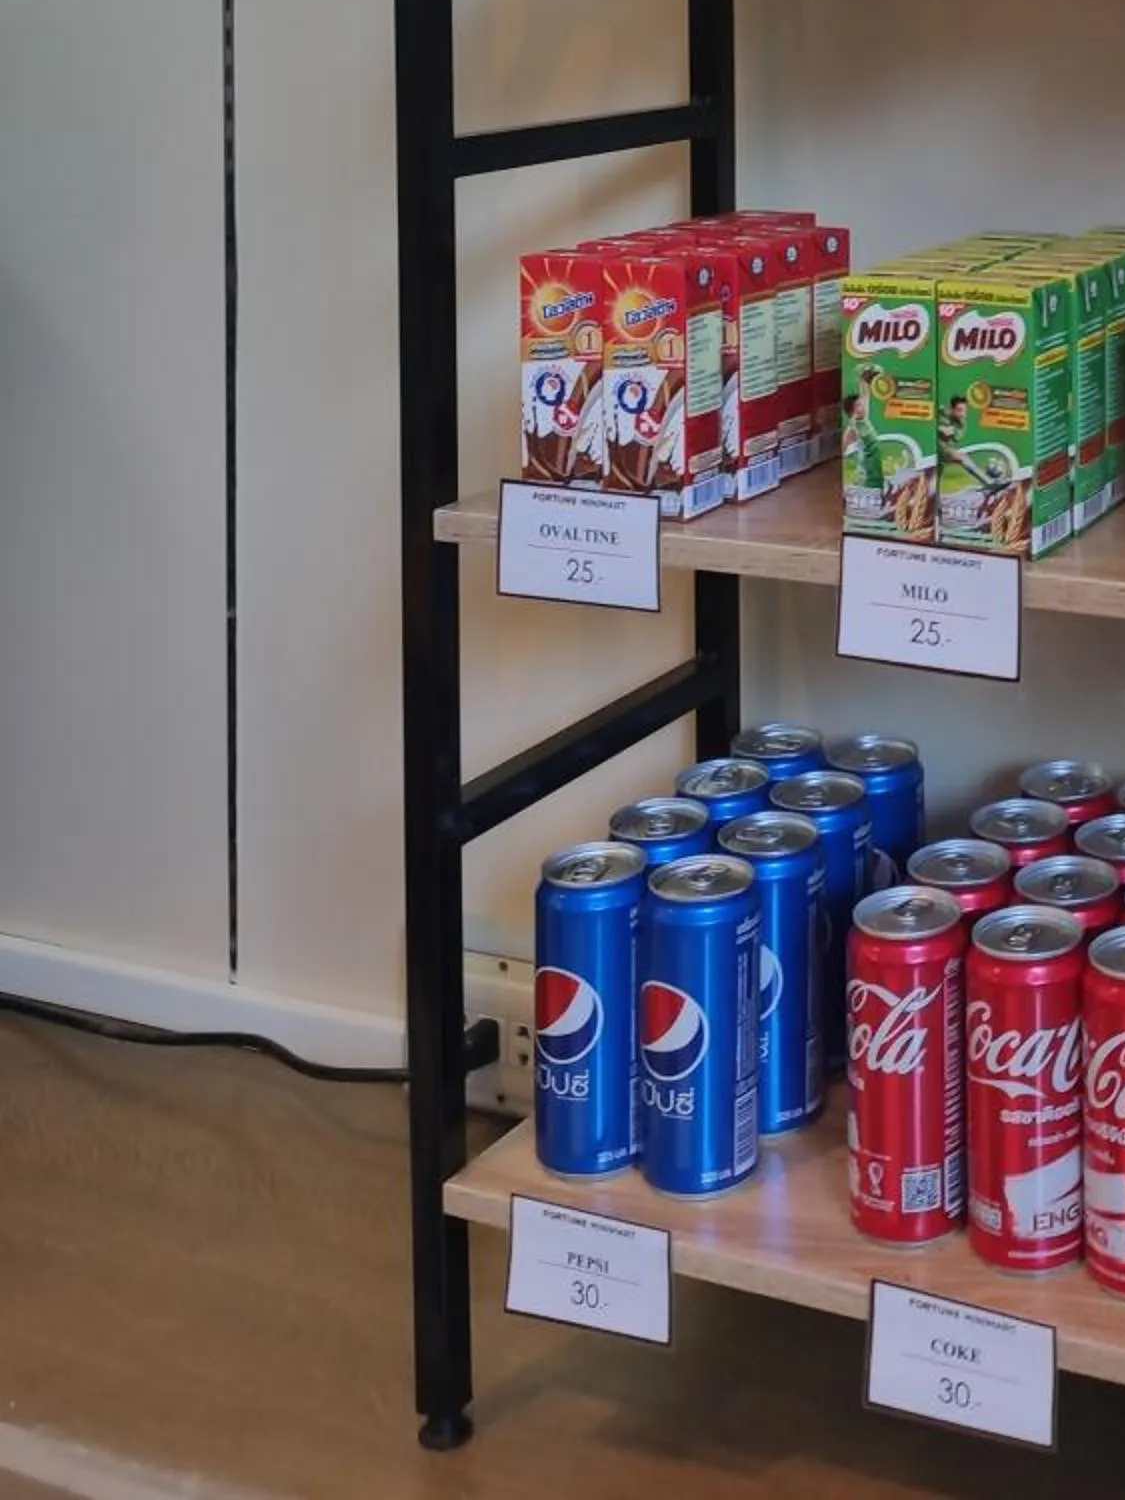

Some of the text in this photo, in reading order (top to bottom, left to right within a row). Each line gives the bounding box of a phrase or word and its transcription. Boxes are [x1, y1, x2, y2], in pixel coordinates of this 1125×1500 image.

[857, 319, 921, 345] MILO
[953, 327, 1017, 352] MILO
[539, 523, 621, 546] OVALTINE
[901, 583, 948, 604] MILO
[567, 1251, 610, 1274] PEPSI
[930, 1338, 982, 1364] COKE
